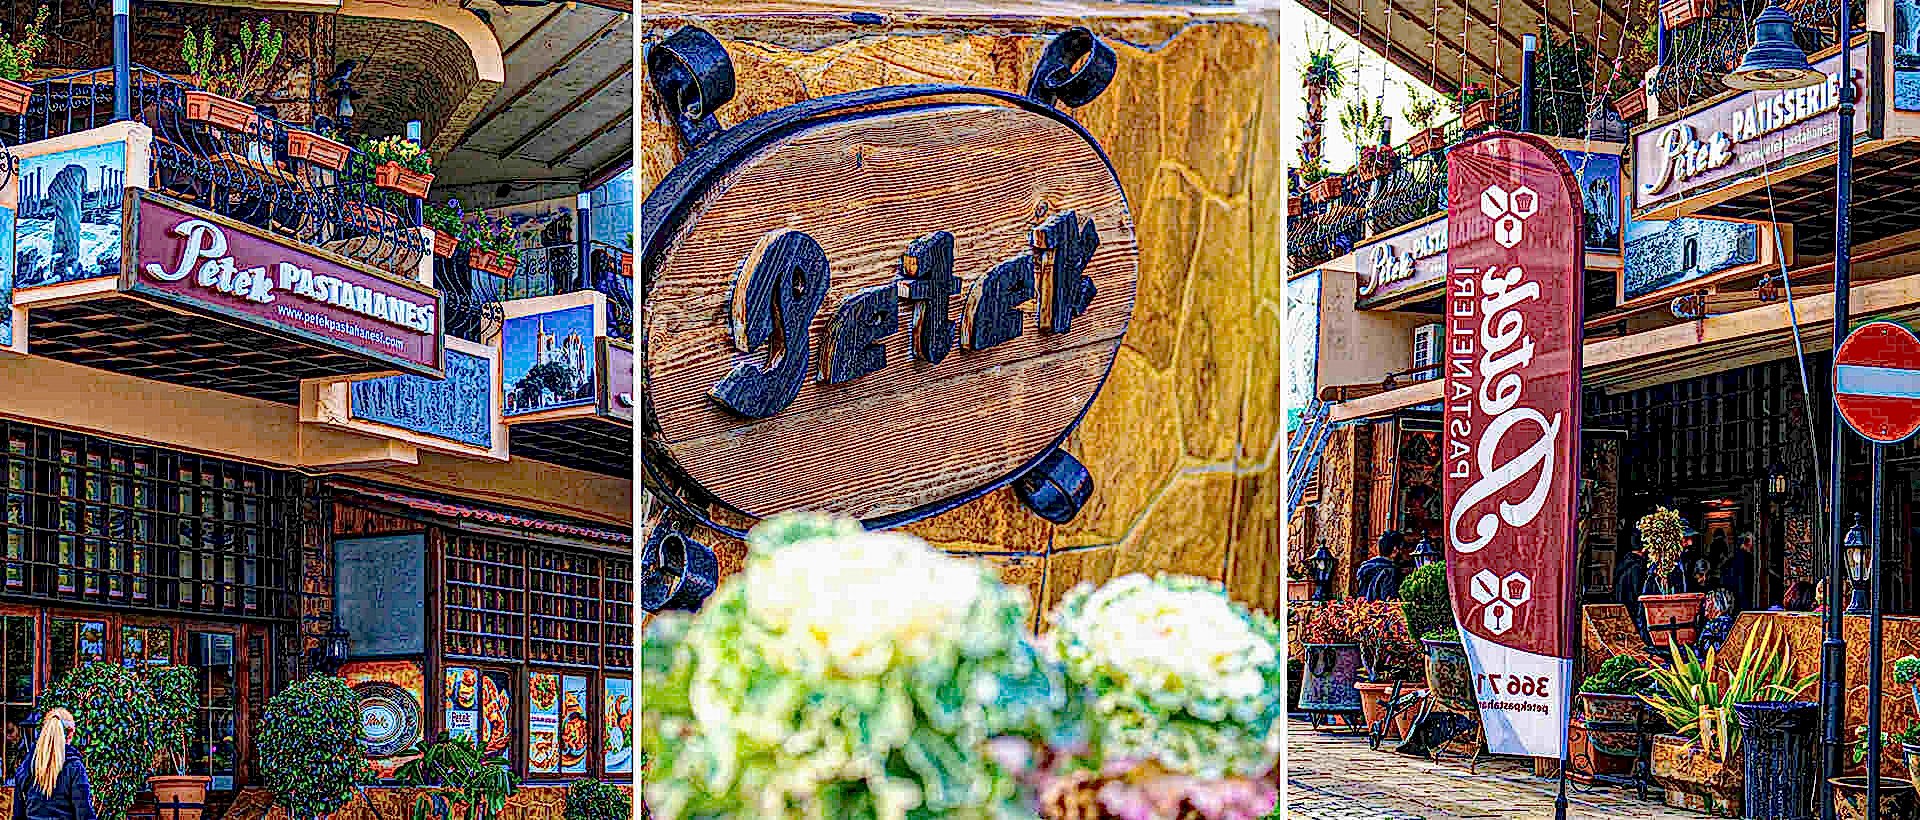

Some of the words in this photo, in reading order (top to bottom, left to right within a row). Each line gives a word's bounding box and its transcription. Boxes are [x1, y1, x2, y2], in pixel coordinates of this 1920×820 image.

[1640, 122, 1731, 195] Petek
[145, 219, 276, 304] Petek
[1359, 242, 1417, 296] Petek
[277, 303, 405, 349] www.petekpastahanesi.com
[706, 208, 1101, 419] Petek
